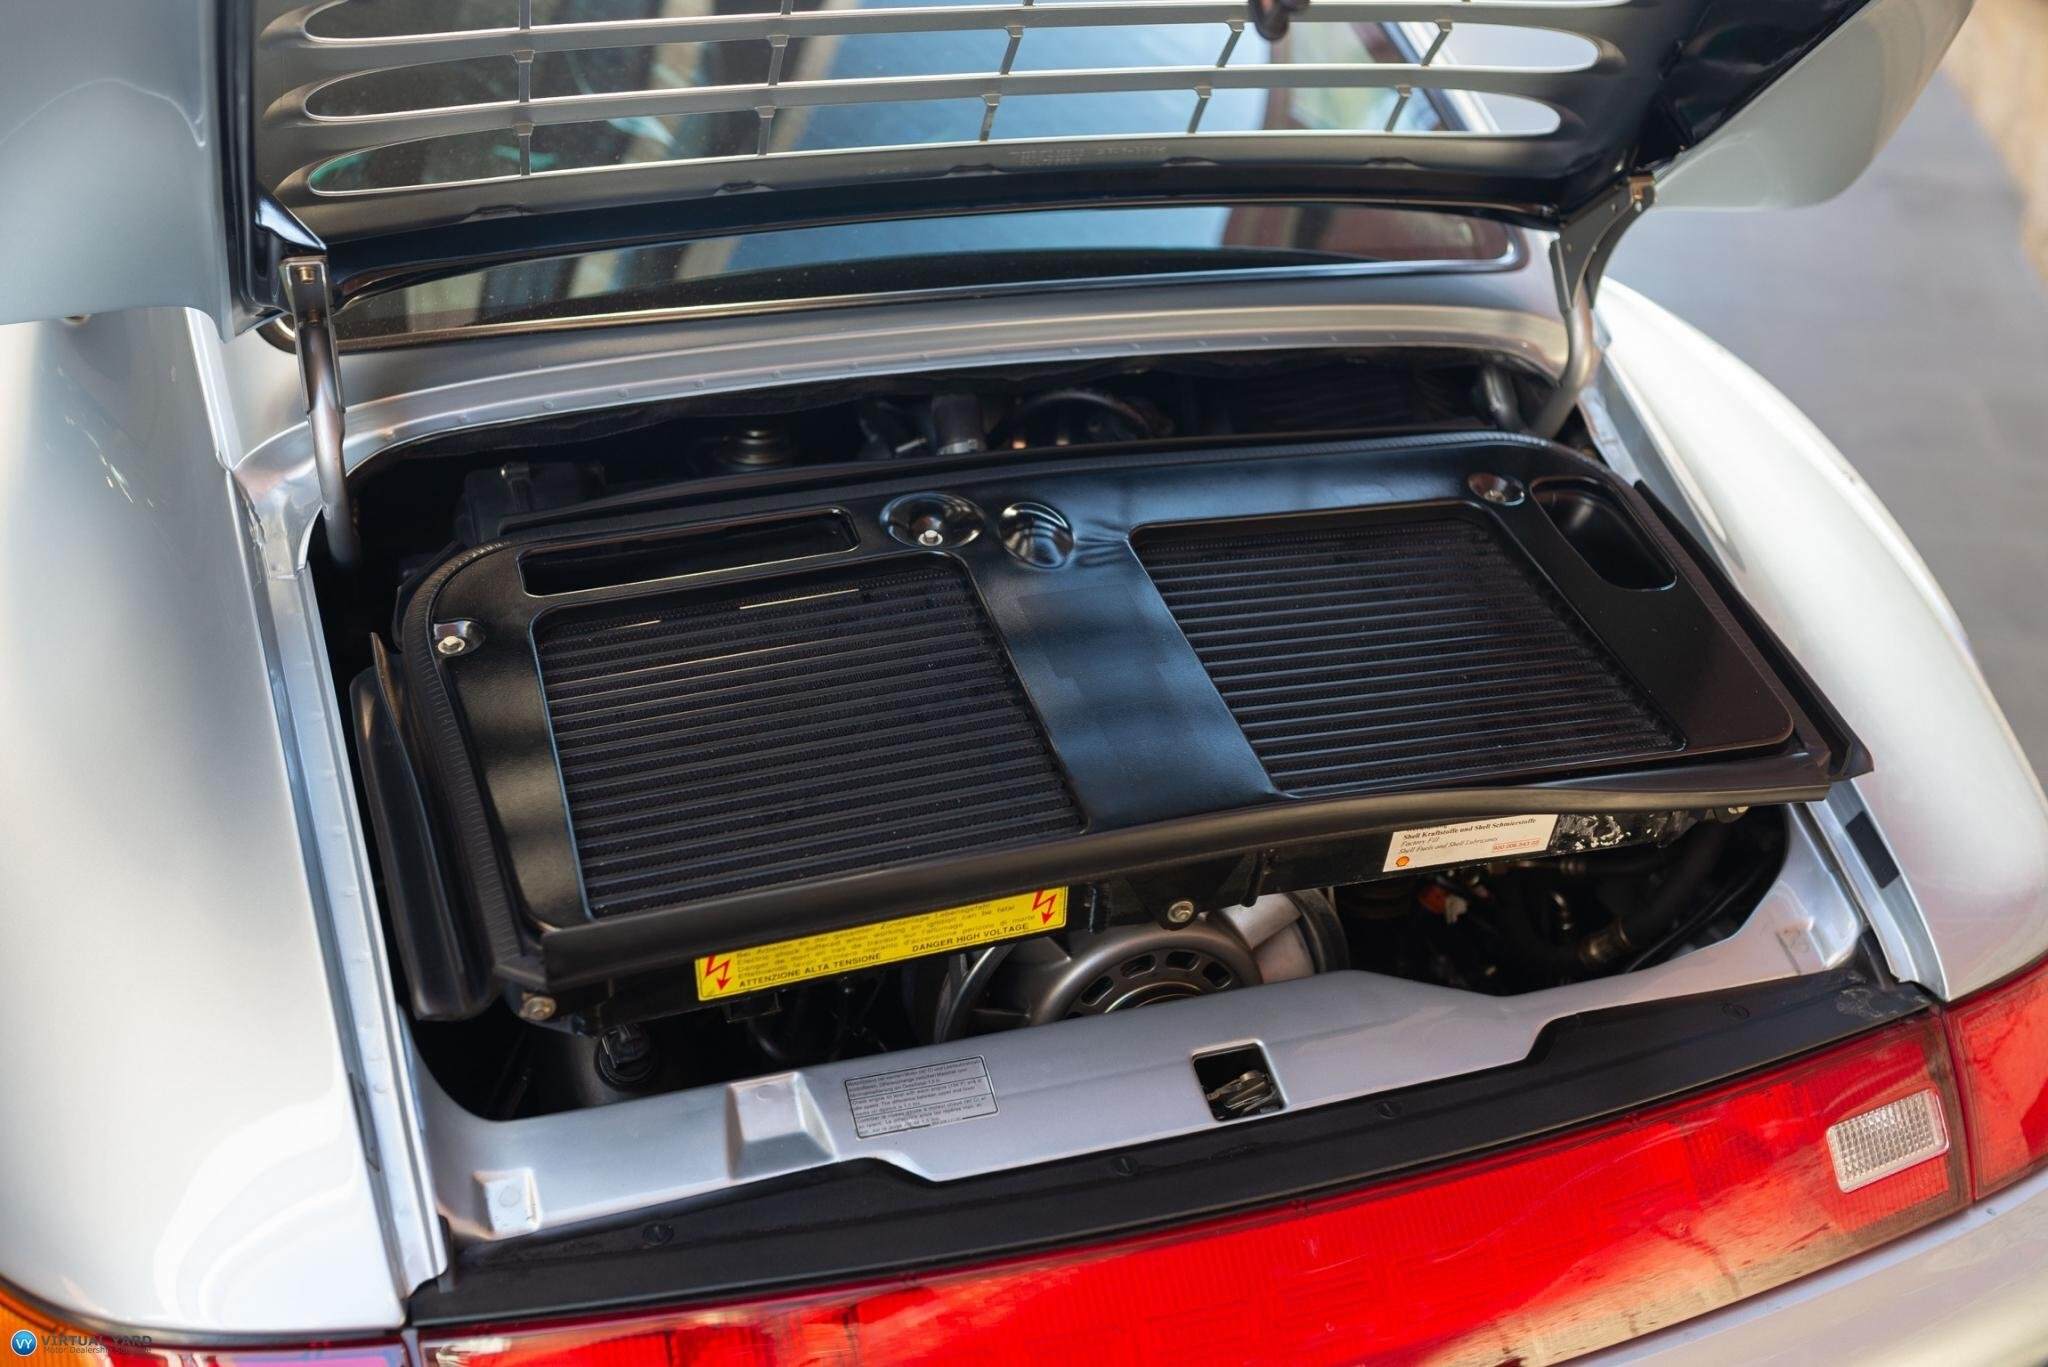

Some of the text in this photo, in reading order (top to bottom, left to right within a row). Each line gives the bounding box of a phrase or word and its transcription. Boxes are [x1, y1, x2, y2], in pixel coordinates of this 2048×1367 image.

[738, 924, 1028, 987] ATTENZIONE ALTA TENSIONE DANGER HIGH VOLTAGE
